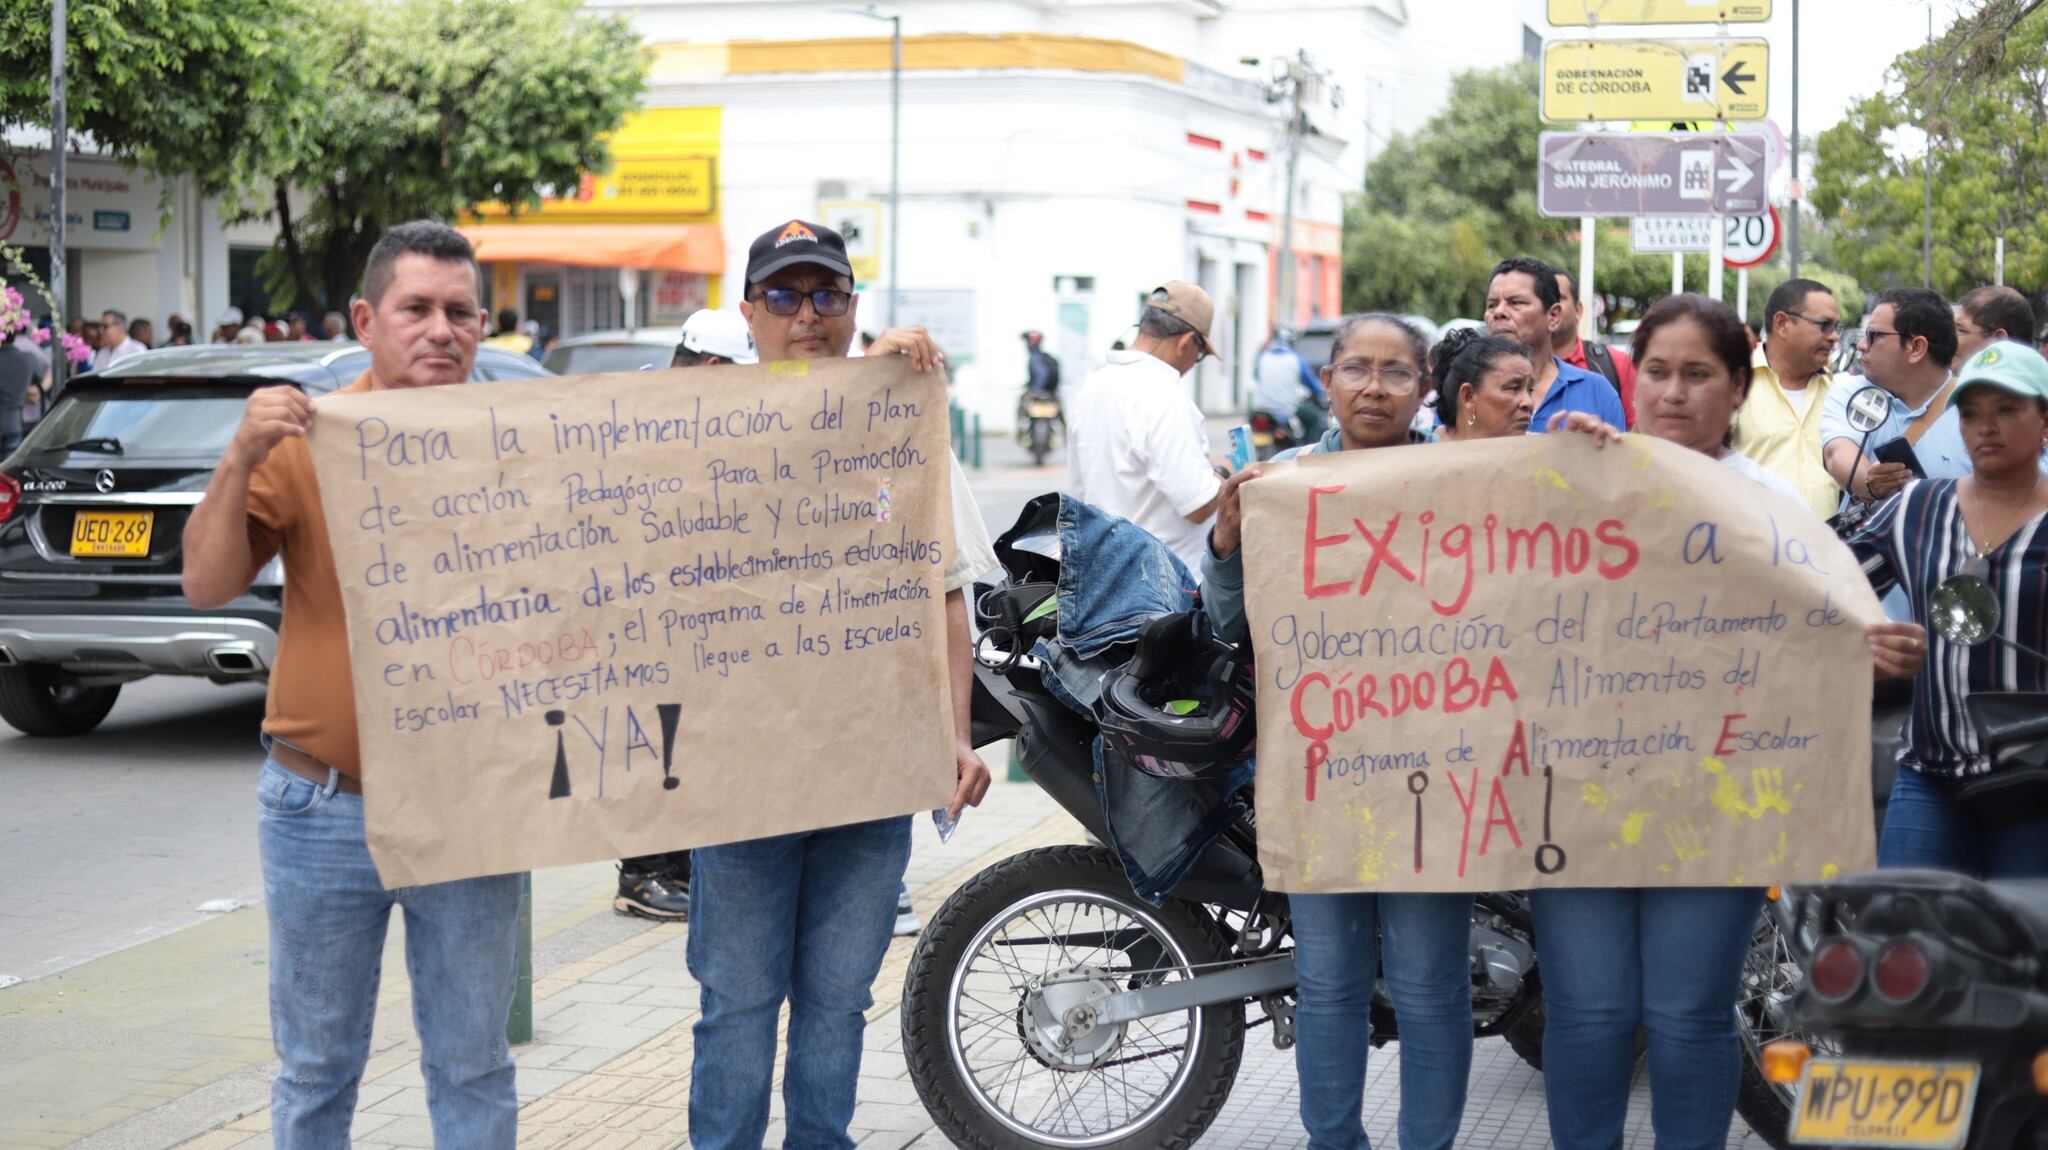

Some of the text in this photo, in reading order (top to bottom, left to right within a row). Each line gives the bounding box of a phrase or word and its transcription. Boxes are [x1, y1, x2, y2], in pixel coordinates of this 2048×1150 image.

[1556, 67, 1643, 79] GOBERNACIÓN
[1556, 78, 1652, 94] DE CÓRDOBA
[1553, 170, 1672, 189] SAN JERÓNIMO
[1555, 160, 1622, 173] ATEDRAL
[1648, 232, 1711, 245] SEGURO
[1727, 215, 1764, 247] 20
[355, 388, 920, 481] Para la implementación del plan
[359, 486, 407, 534] de
[432, 471, 531, 518] acción
[773, 447, 797, 482] la
[365, 542, 408, 587] de
[433, 515, 619, 575] alimentación
[641, 498, 752, 544] Saludable
[796, 493, 877, 529] Cultura
[1682, 521, 1724, 565] a
[1769, 513, 1830, 576] la
[375, 525, 942, 645] alimentaria de los establecimientos educativos
[383, 661, 437, 687] en
[624, 608, 647, 643] el
[779, 584, 806, 615] de
[819, 577, 932, 617] Alimentación
[693, 642, 752, 677] llegue
[765, 642, 783, 657] a
[796, 624, 831, 656] las
[1271, 610, 1512, 691] gobernación
[1535, 591, 1588, 645] del
[1806, 590, 1847, 628] de
[1290, 648, 1761, 741] CÓRDOBA Alimentos del
[544, 703, 682, 800] ¡YA!
[1304, 713, 1820, 802] Programa de Alimentación Escolar
